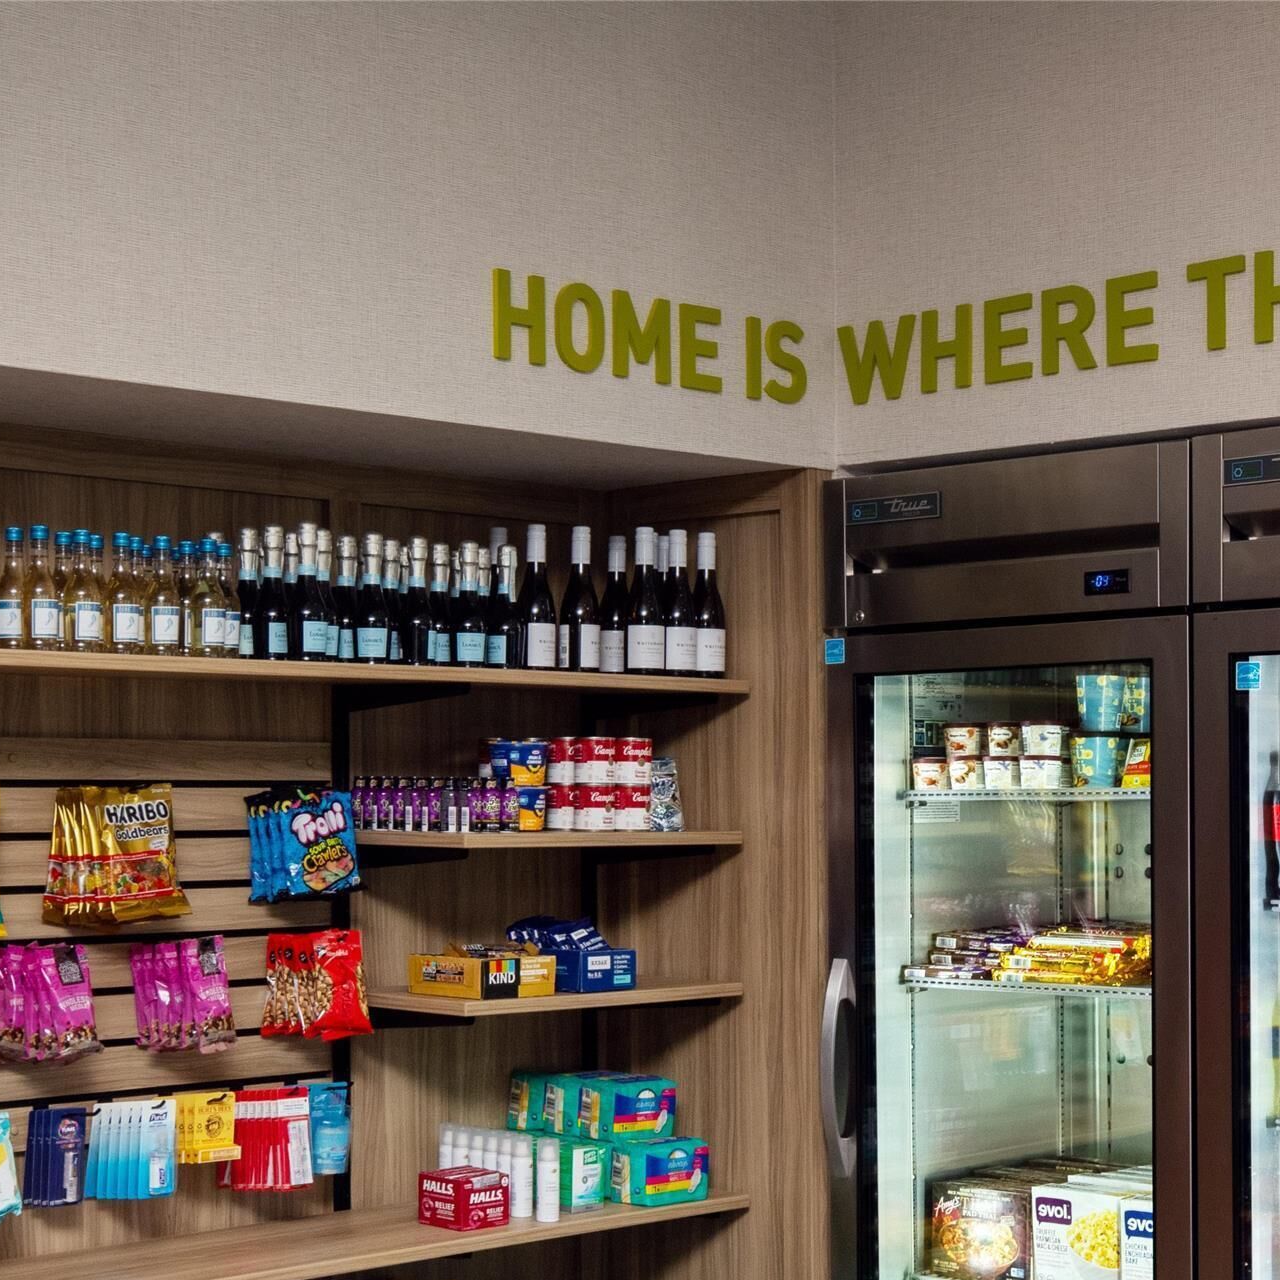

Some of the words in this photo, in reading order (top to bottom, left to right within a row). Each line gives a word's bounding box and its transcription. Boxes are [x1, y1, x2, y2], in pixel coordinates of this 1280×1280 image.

[492, 268, 721, 393] HOME
[745, 316, 807, 404] IS
[837, 271, 1158, 404] WHERE
[104, 801, 169, 825] HARIBO
[292, 802, 346, 844] Trolli
[115, 825, 169, 841] Goldbears
[489, 972, 516, 984] KIND
[434, 1201, 455, 1211] RELIEF
[933, 1196, 962, 1217] Amy's
